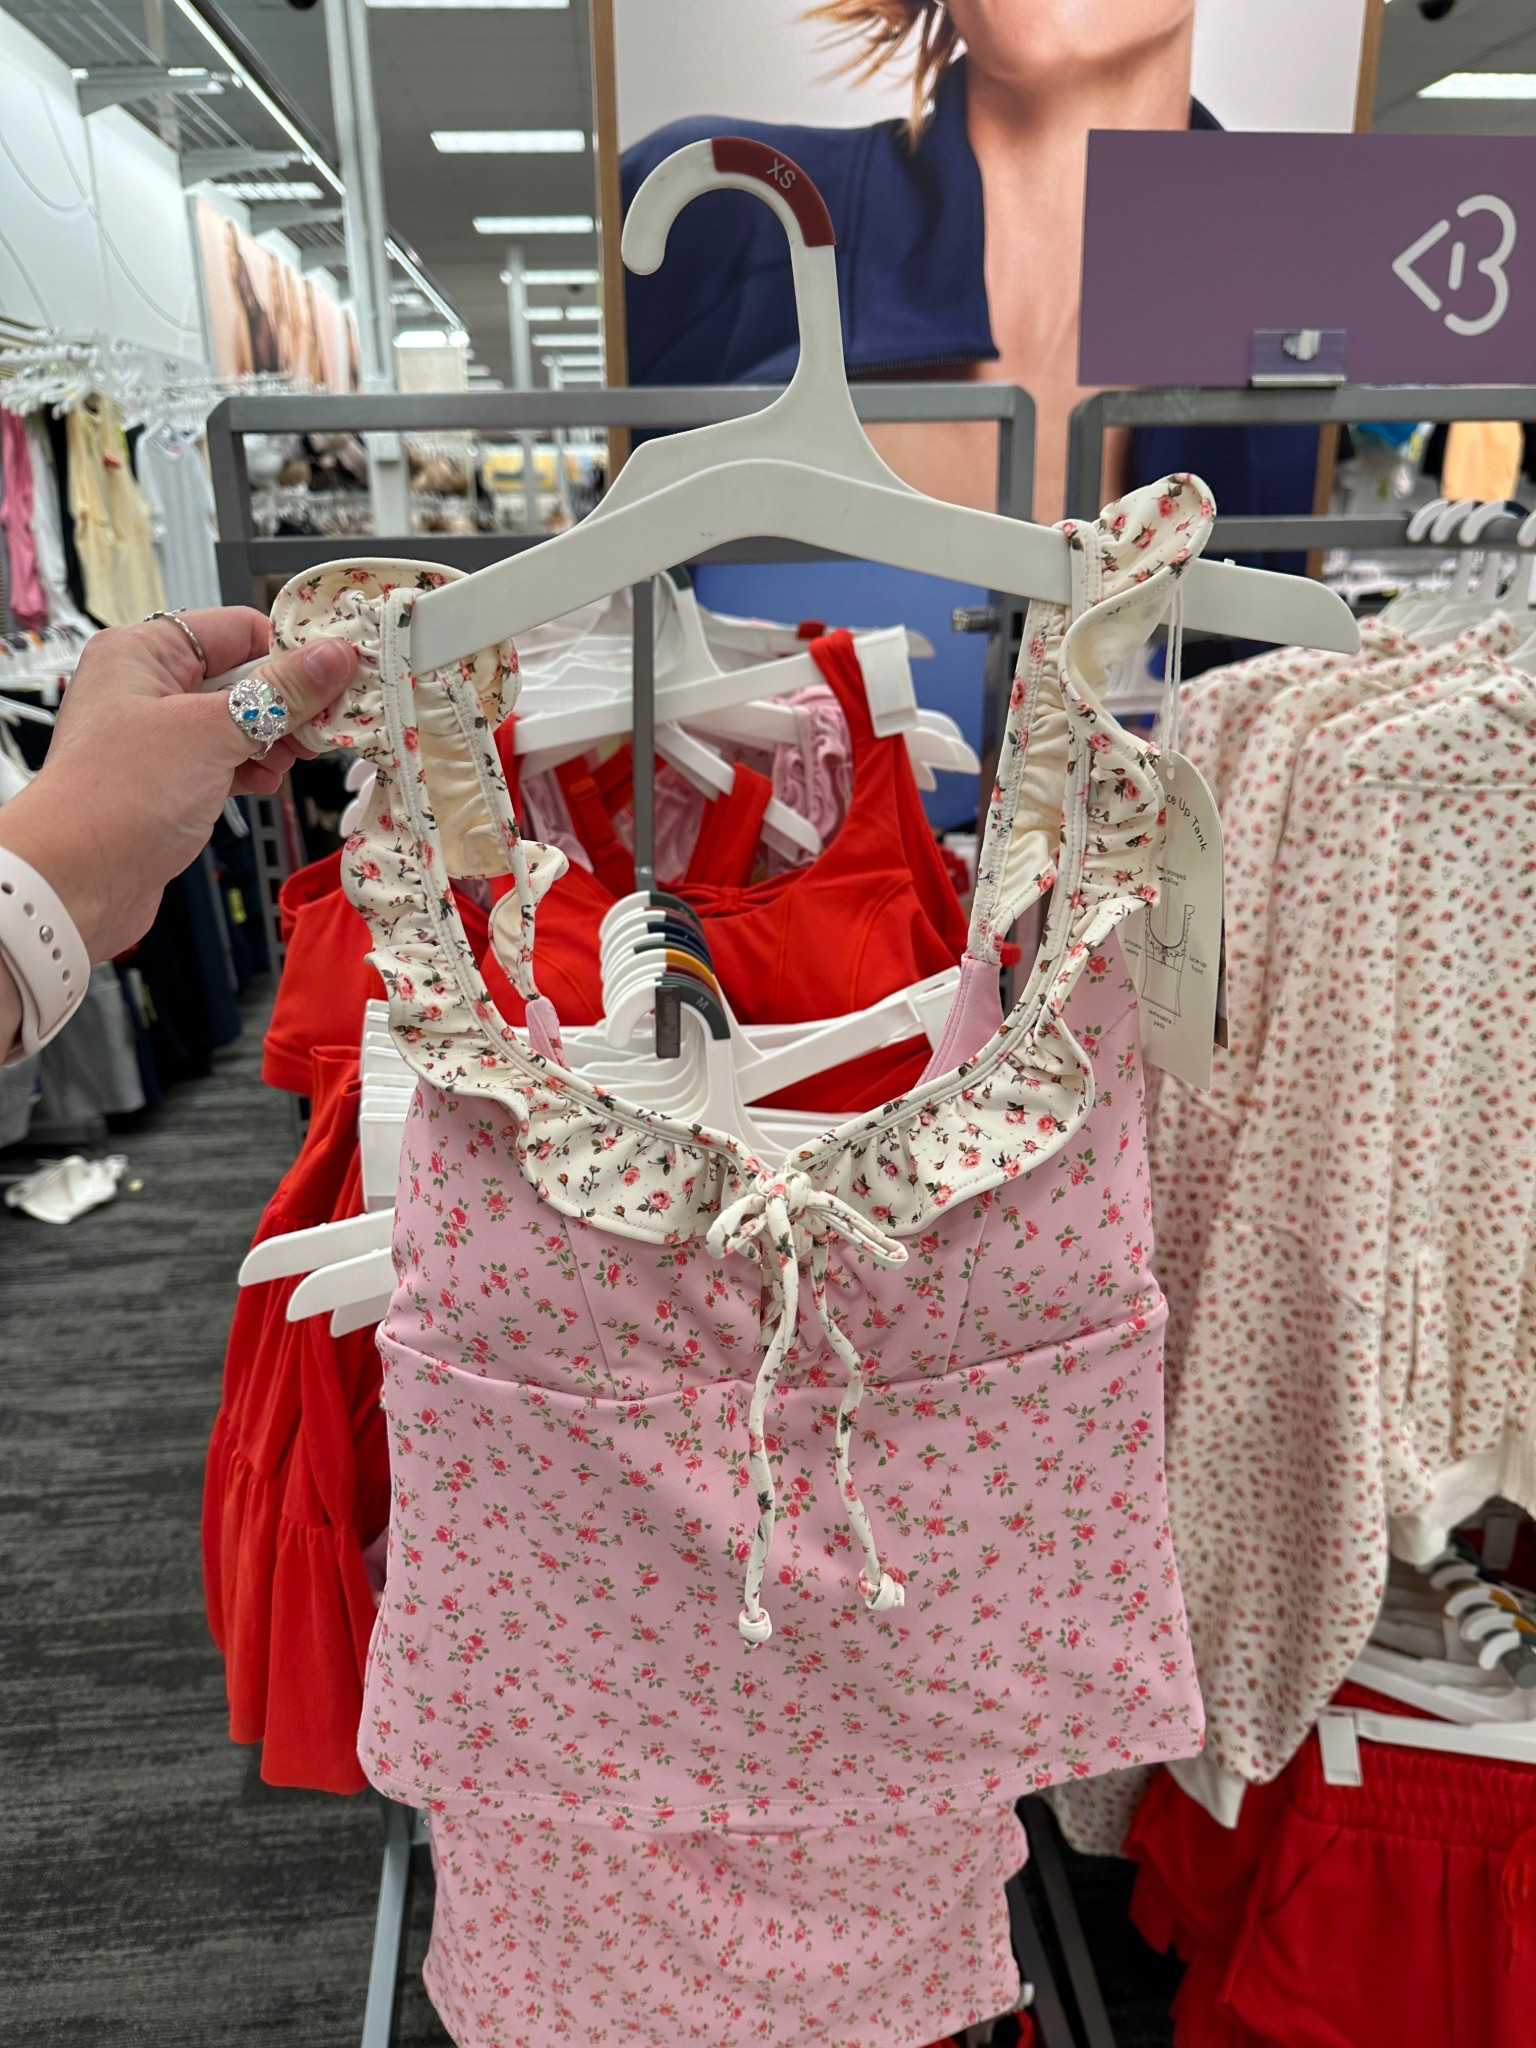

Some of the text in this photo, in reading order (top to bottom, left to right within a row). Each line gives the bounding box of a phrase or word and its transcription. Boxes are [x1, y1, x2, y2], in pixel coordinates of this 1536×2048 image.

[766, 157, 796, 189] XS
[1179, 797, 1191, 817] Up
[1192, 816, 1208, 852] Tank
[695, 996, 710, 1010] M
